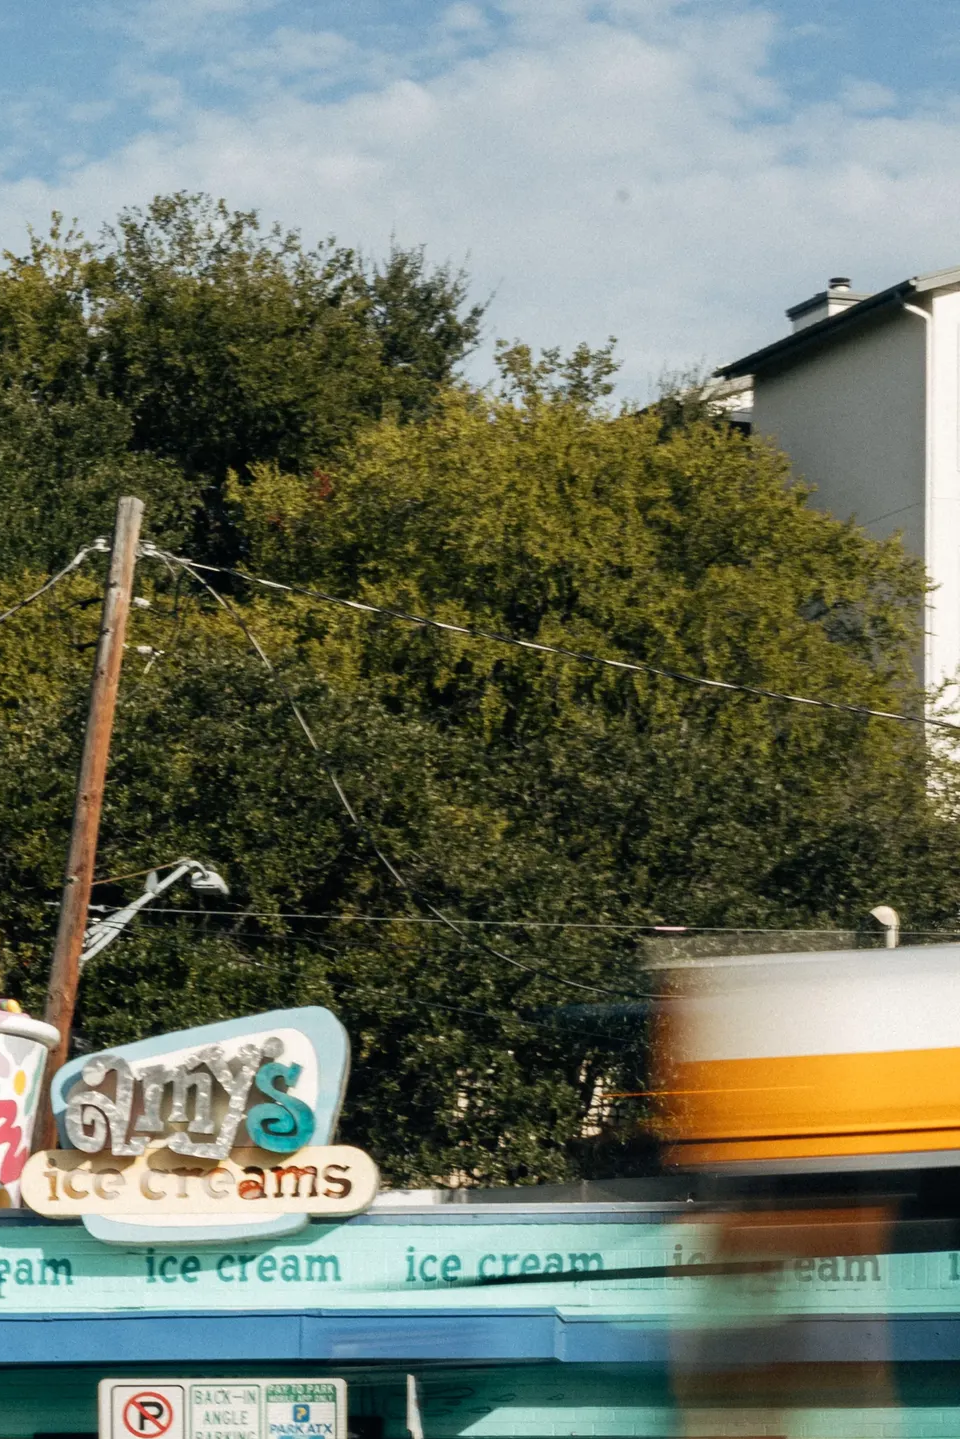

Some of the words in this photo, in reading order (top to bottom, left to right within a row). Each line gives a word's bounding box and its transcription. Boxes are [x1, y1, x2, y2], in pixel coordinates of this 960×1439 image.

[42, 1157, 126, 1201] ice
[139, 1164, 353, 1199] creams
[145, 1247, 201, 1284] ice
[216, 1253, 343, 1283] cream
[405, 1246, 462, 1283] ice
[268, 1385, 288, 1394] PAY
[291, 1385, 304, 1394] TO
[306, 1385, 333, 1394] PARK
[194, 1390, 257, 1405] BACK-IN
[202, 1411, 249, 1425] ANGLE
[270, 1424, 305, 1434] PARK
[308, 1424, 333, 1434] ATX
